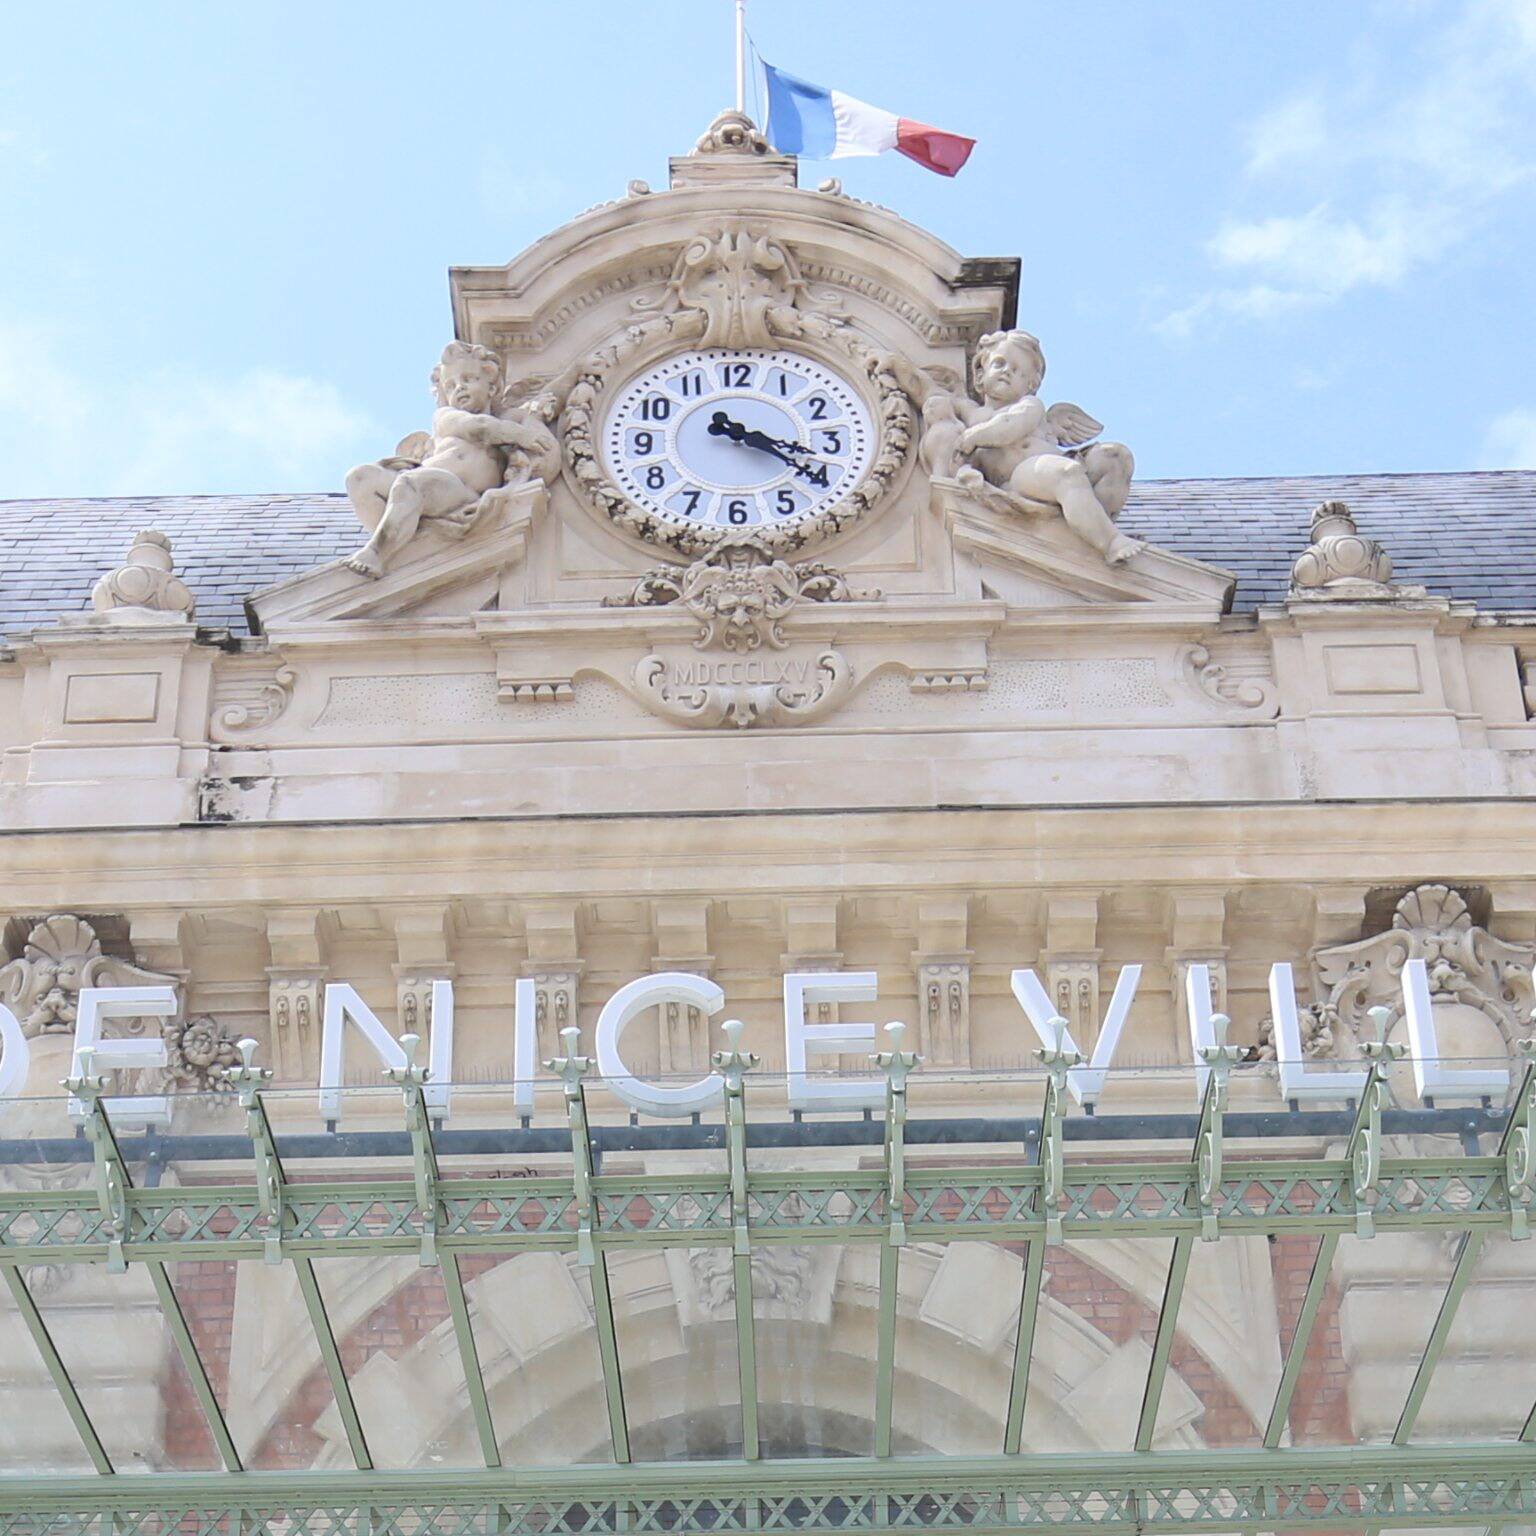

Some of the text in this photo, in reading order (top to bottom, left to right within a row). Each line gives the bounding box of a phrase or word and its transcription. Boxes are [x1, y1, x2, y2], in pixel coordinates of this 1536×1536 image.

[682, 373, 701, 396] 11
[723, 364, 752, 388] 12
[779, 373, 787, 396] 1
[641, 397, 671, 421] 10
[808, 397, 828, 420] 2
[634, 432, 654, 456] 9
[821, 430, 842, 455] 3
[646, 465, 665, 490] 8
[810, 464, 829, 488] 4
[682, 490, 702, 516] 7
[728, 500, 748, 525] 6
[776, 490, 796, 516] 5
[674, 660, 809, 686] MDCCCLXV
[319, 972, 892, 1121] NICE
